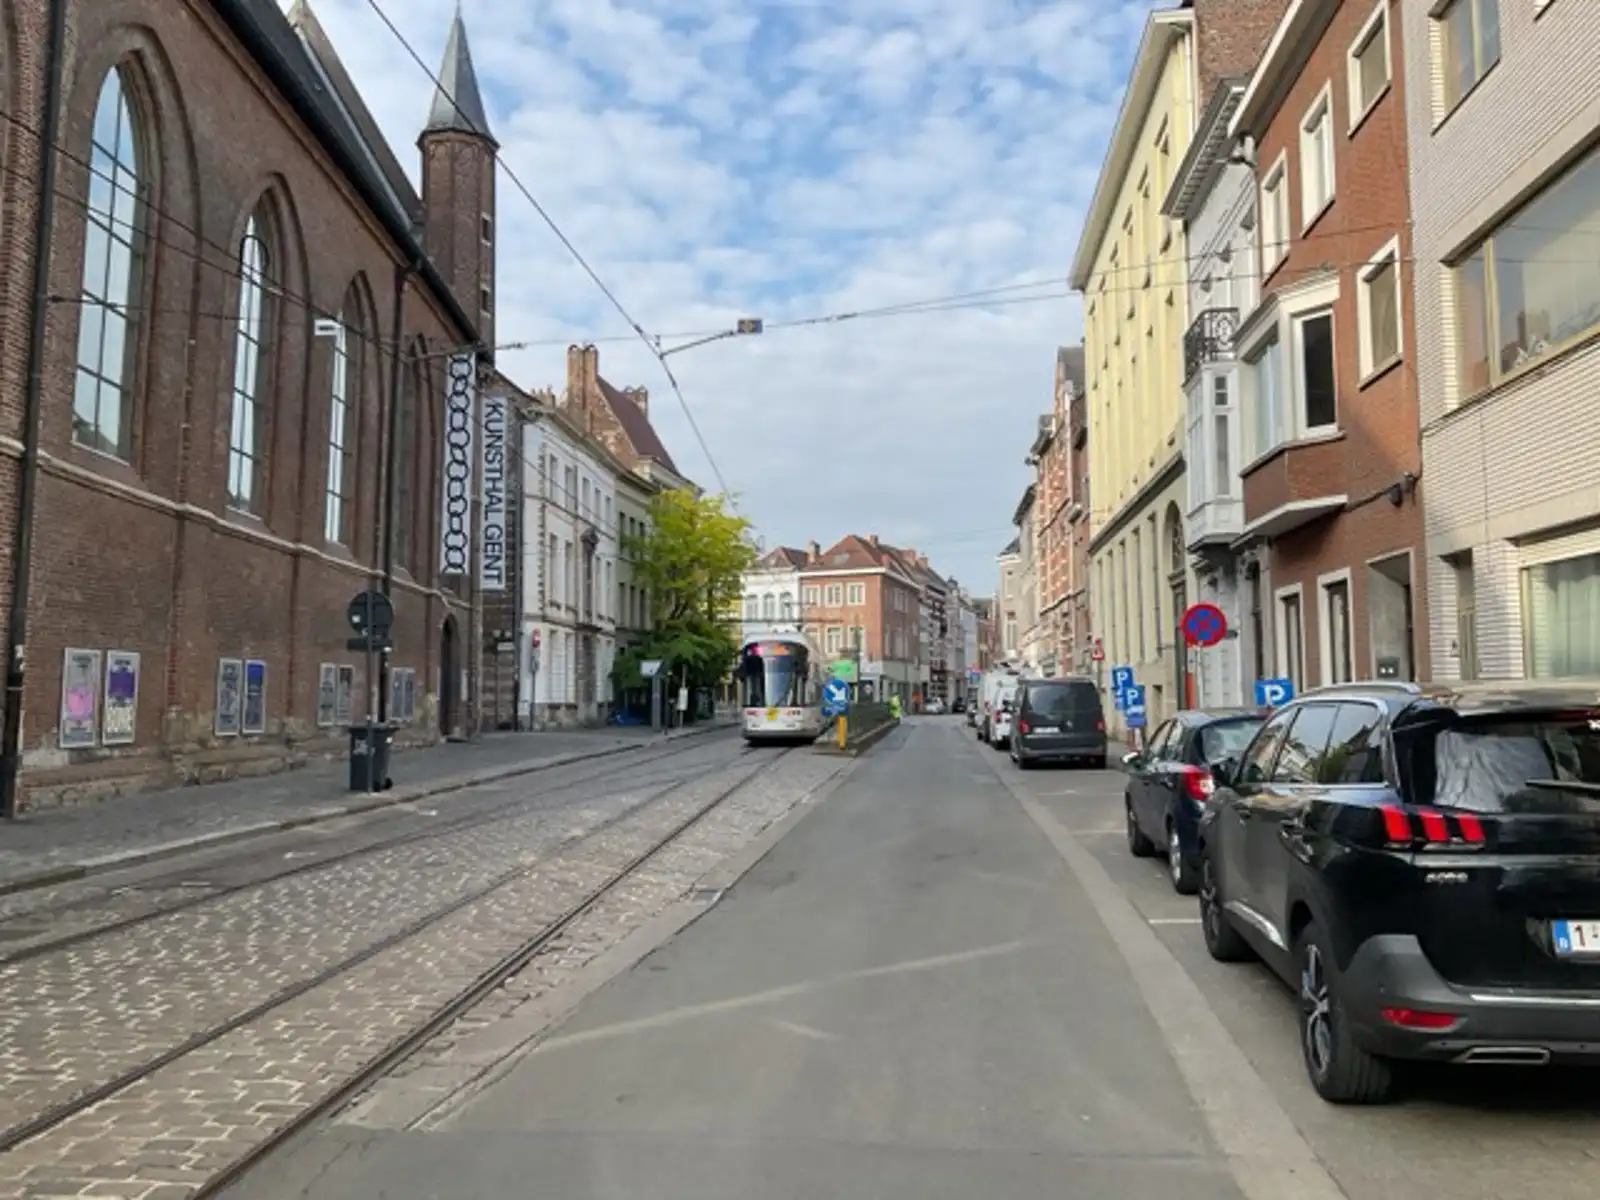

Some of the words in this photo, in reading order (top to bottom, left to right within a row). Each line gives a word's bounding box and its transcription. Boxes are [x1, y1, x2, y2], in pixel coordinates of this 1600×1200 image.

[484, 402, 505, 520] KUNSTHAL
[484, 524, 504, 586] GENT
[1117, 672, 1128, 685] P
[1127, 689, 1139, 705] P
[1264, 684, 1285, 706] P
